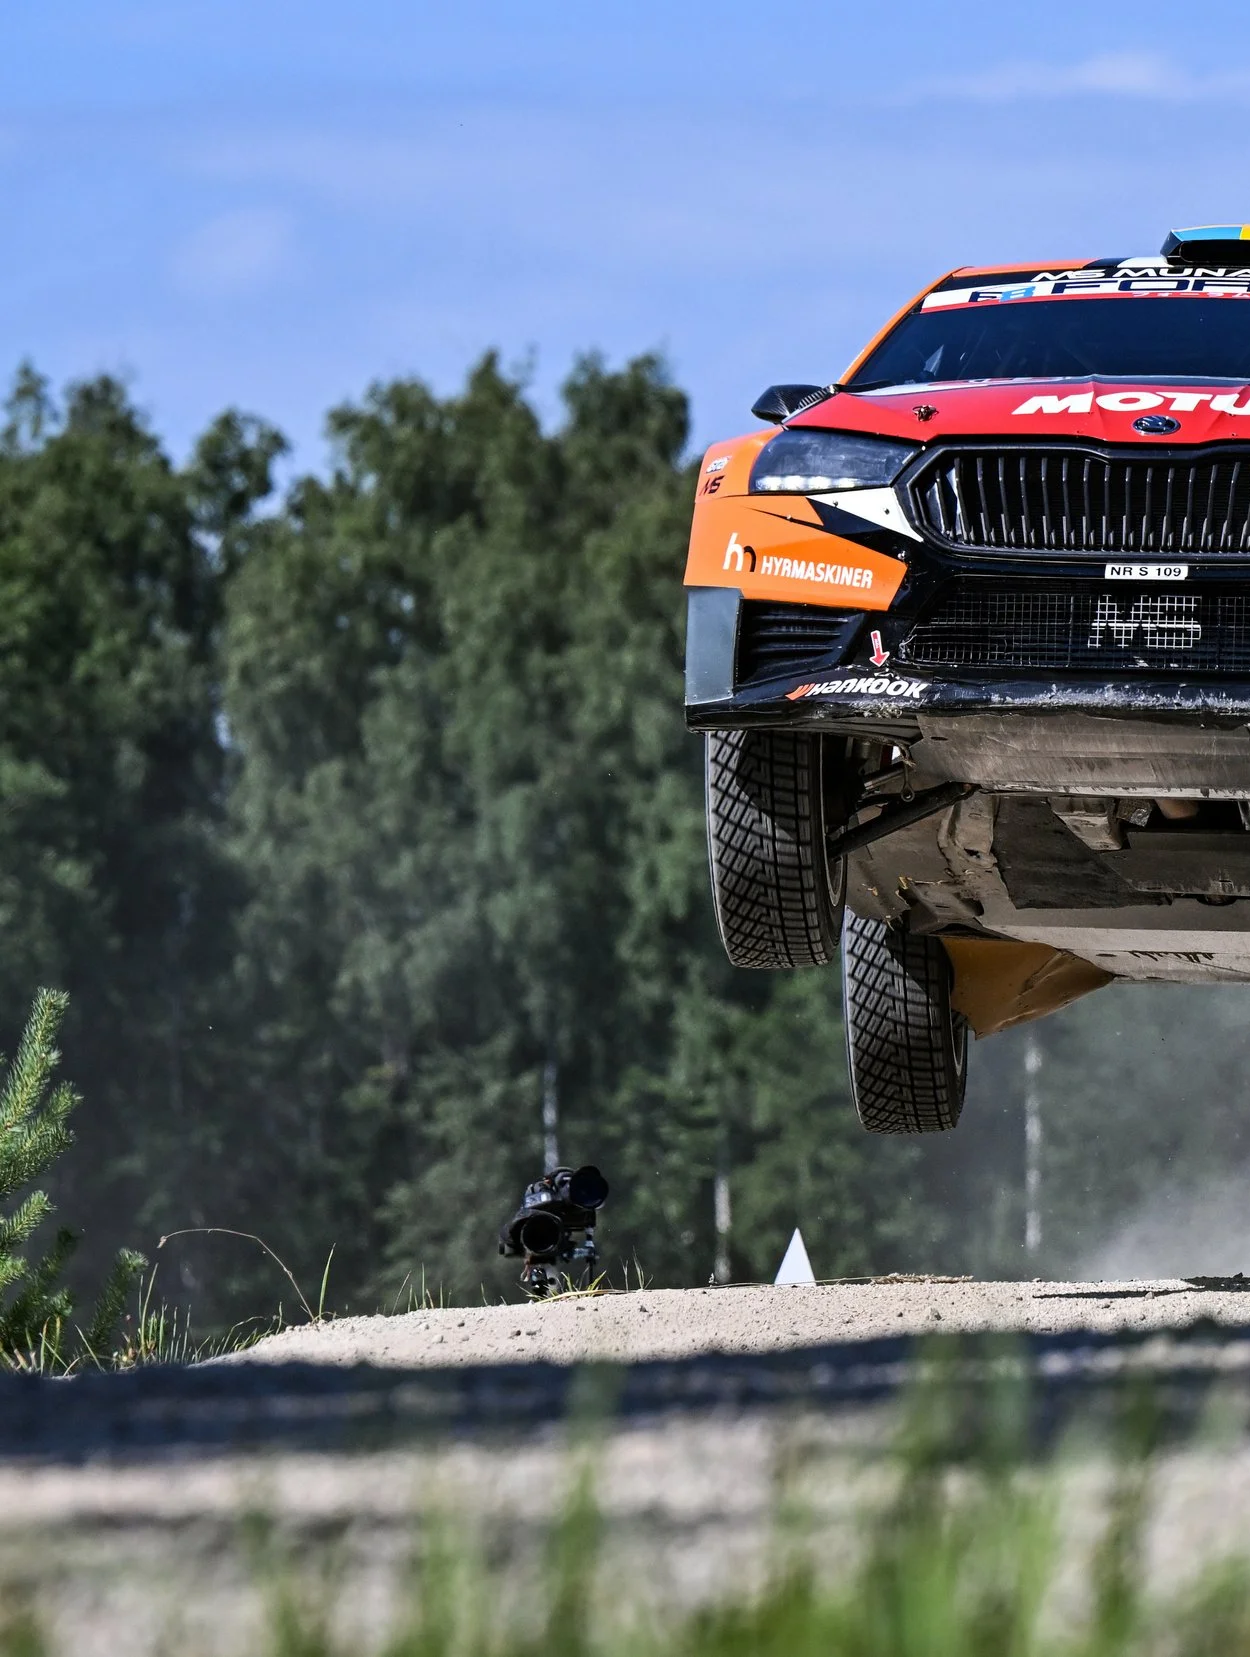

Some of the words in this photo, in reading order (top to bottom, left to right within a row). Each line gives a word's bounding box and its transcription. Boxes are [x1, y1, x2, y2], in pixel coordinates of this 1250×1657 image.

[1031, 270, 1106, 282] MS
[760, 555, 873, 589] HYRMASKINER
[1110, 566, 1133, 577] NR
[1139, 566, 1149, 577] S
[1156, 567, 1182, 577] 109
[1087, 594, 1201, 649] MS
